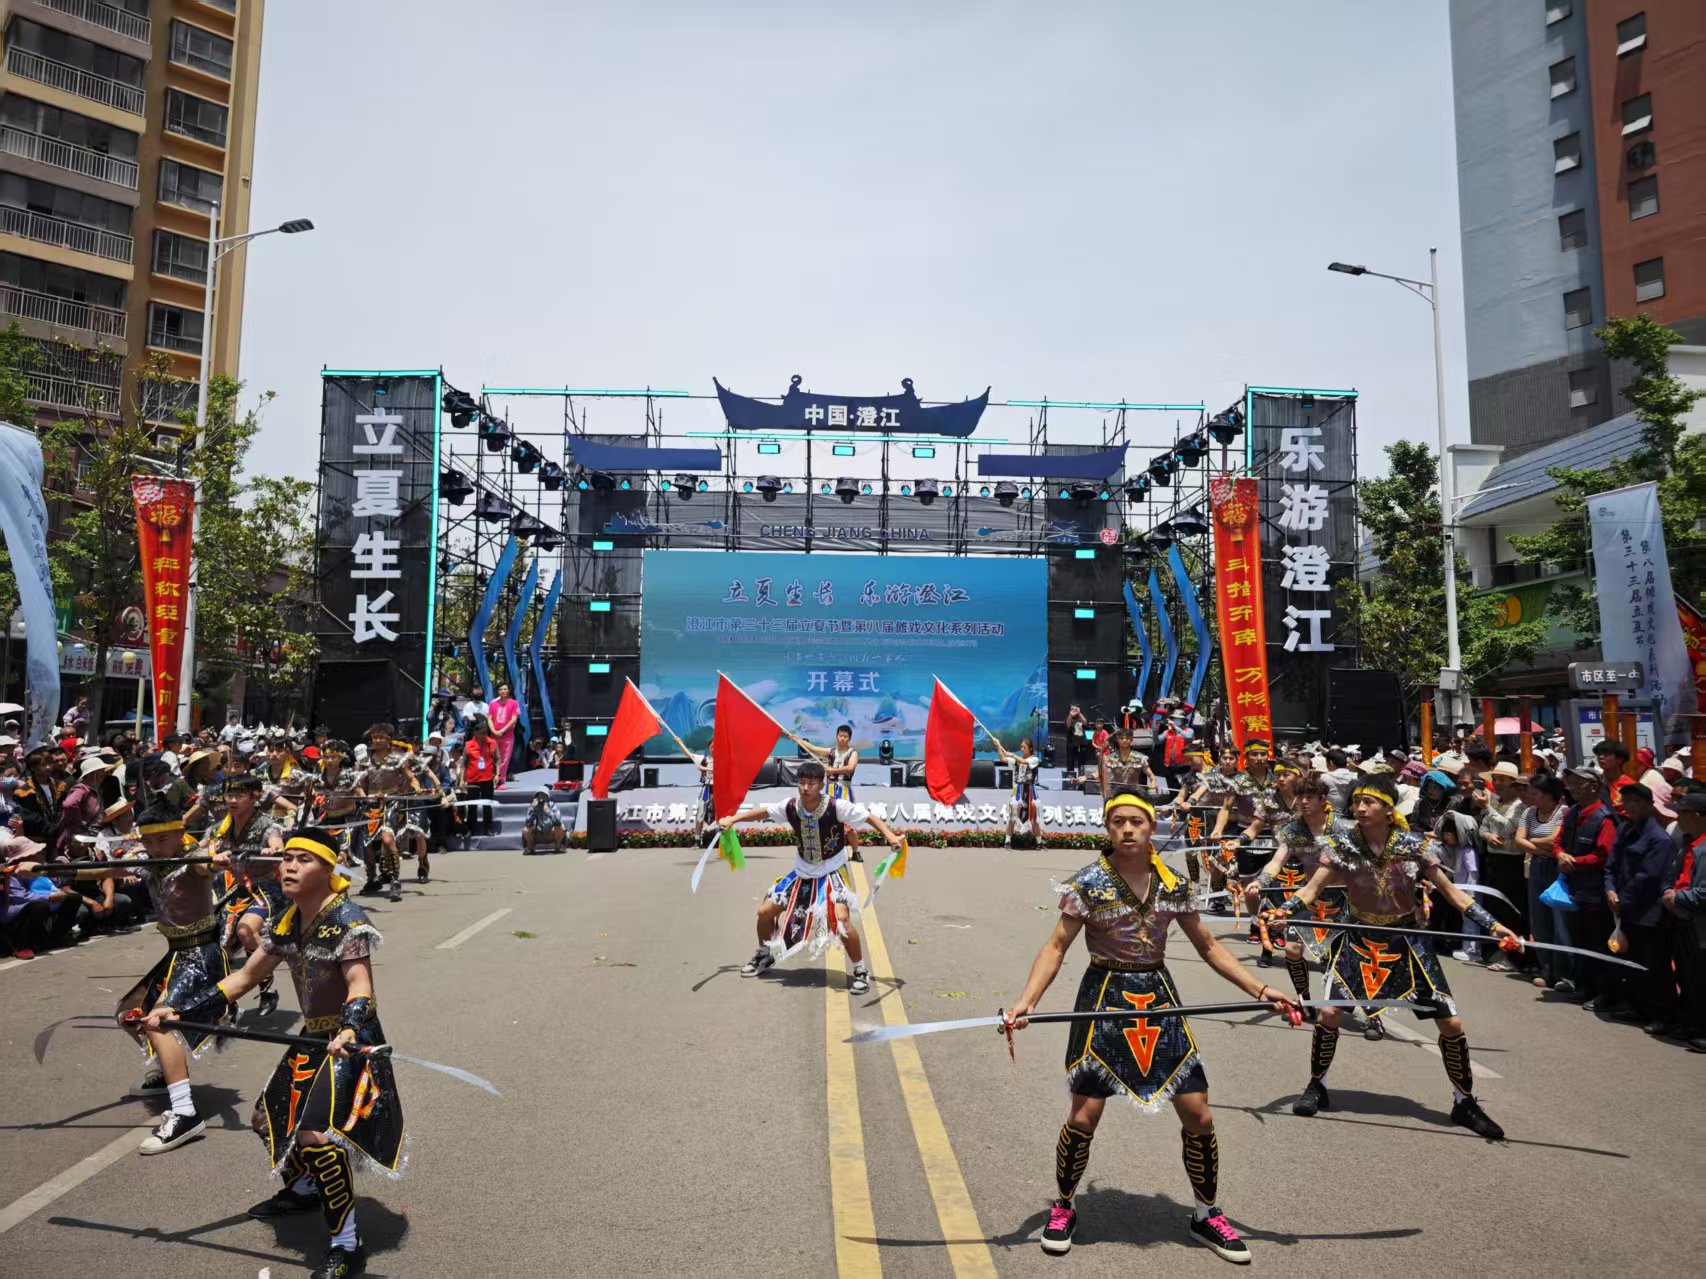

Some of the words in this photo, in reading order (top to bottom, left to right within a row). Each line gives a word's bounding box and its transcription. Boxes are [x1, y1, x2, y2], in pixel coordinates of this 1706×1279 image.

[804, 404, 900, 428] 中国·澄江
[349, 408, 403, 644] 立夏生长
[760, 524, 816, 539] CHENG
[823, 526, 872, 540] JIANG
[880, 527, 931, 541] CHINA
[1279, 427, 1334, 652] 乐游澄江
[722, 577, 835, 607] 立夏生长
[858, 578, 971, 607] 乐游澄江
[686, 616, 1004, 637] 澄江市第三十三届立夏节暨第八届傩戏文化系列活动
[807, 670, 881, 693] 开幕式
